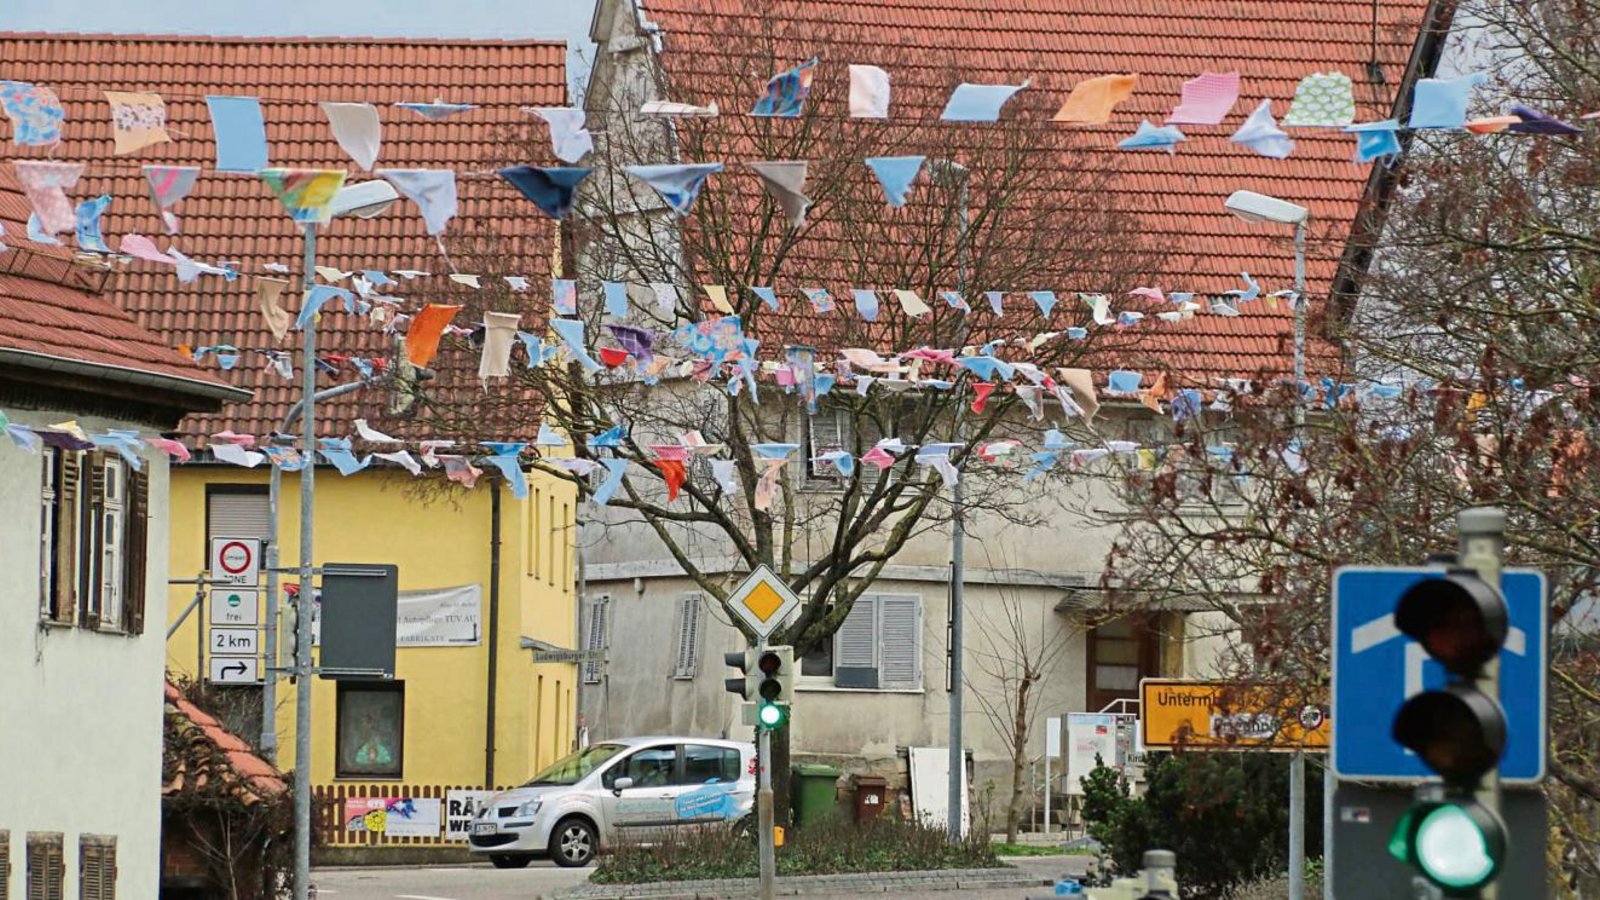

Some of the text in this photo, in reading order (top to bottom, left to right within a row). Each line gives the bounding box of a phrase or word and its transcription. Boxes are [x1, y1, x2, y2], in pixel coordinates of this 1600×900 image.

[226, 612, 242, 621] frei
[216, 634, 251, 648] 2 km
